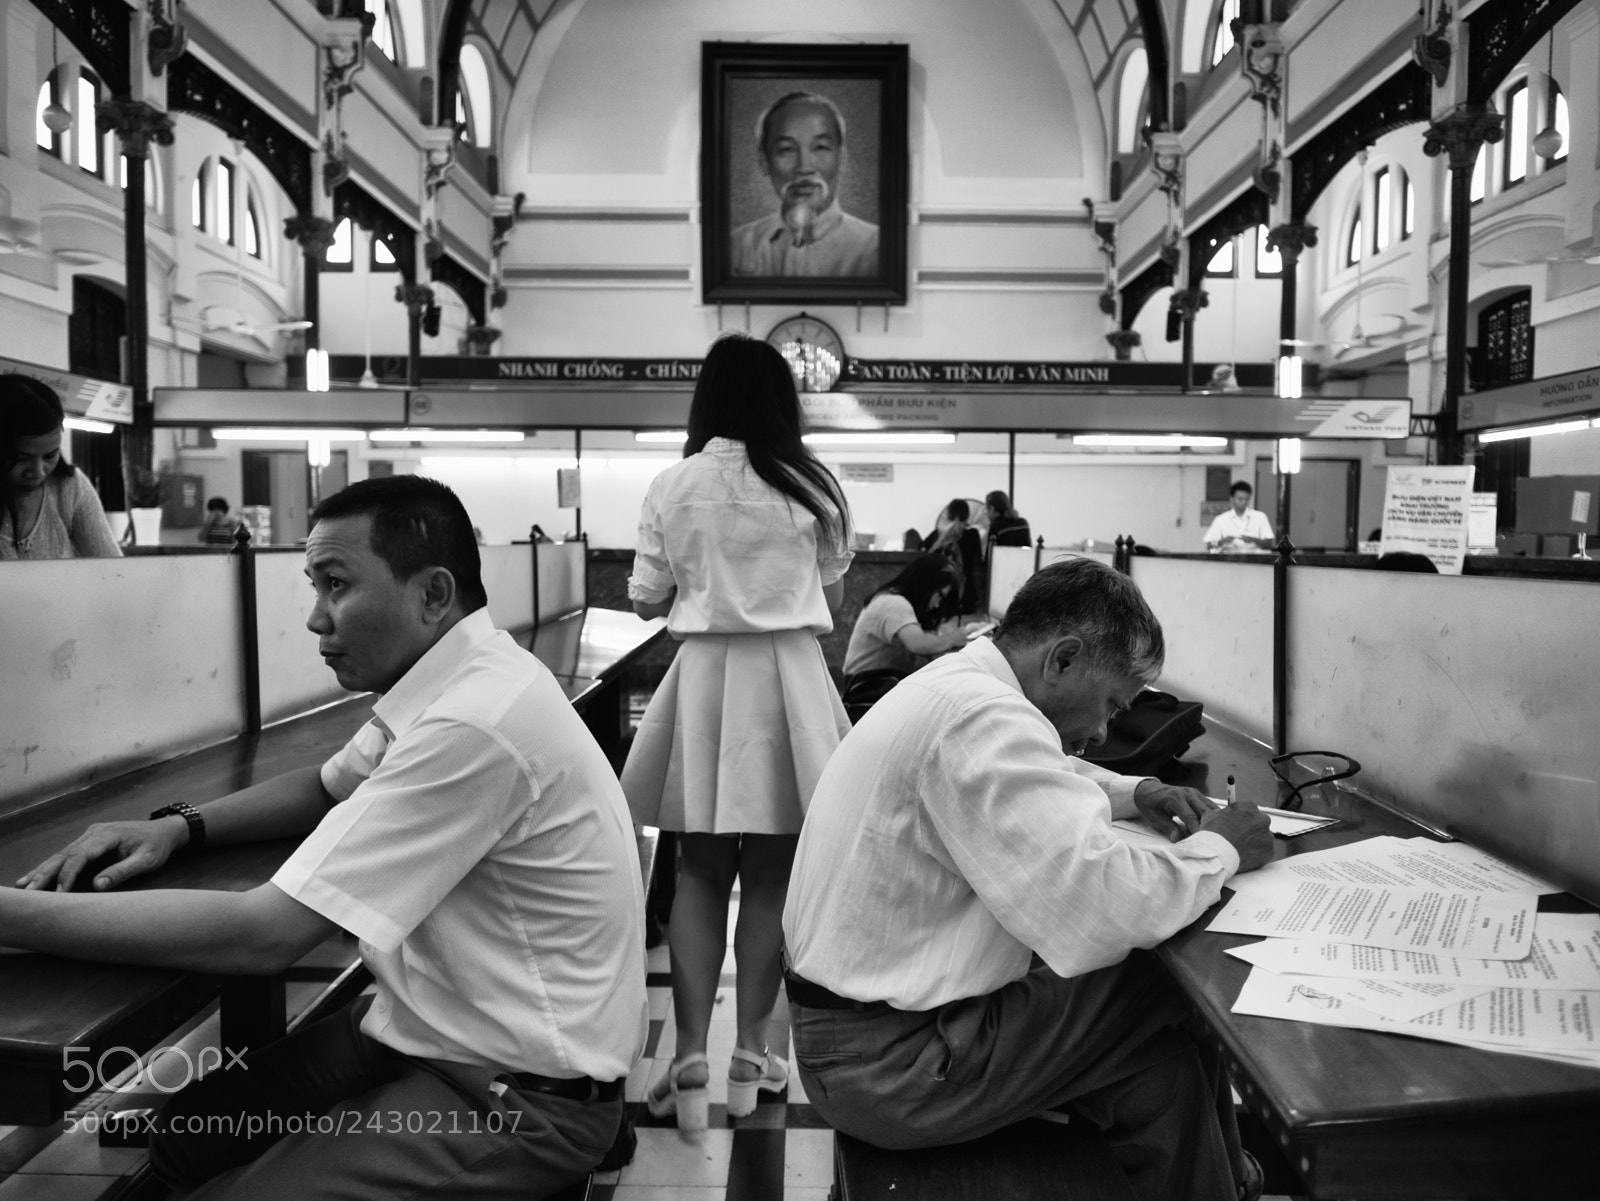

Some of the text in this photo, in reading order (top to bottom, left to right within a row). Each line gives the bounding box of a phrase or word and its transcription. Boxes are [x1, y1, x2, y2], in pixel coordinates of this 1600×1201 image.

[498, 362, 559, 377] NHANH
[563, 361, 624, 378] CHÓNG
[645, 362, 703, 378] CHÍNH
[861, 365, 884, 379] AN
[888, 364, 932, 380] TOÀN
[944, 364, 983, 382] TIỆN
[986, 366, 1015, 382] LỢI
[1027, 364, 1062, 381] VĂN
[1064, 367, 1110, 382] MINH
